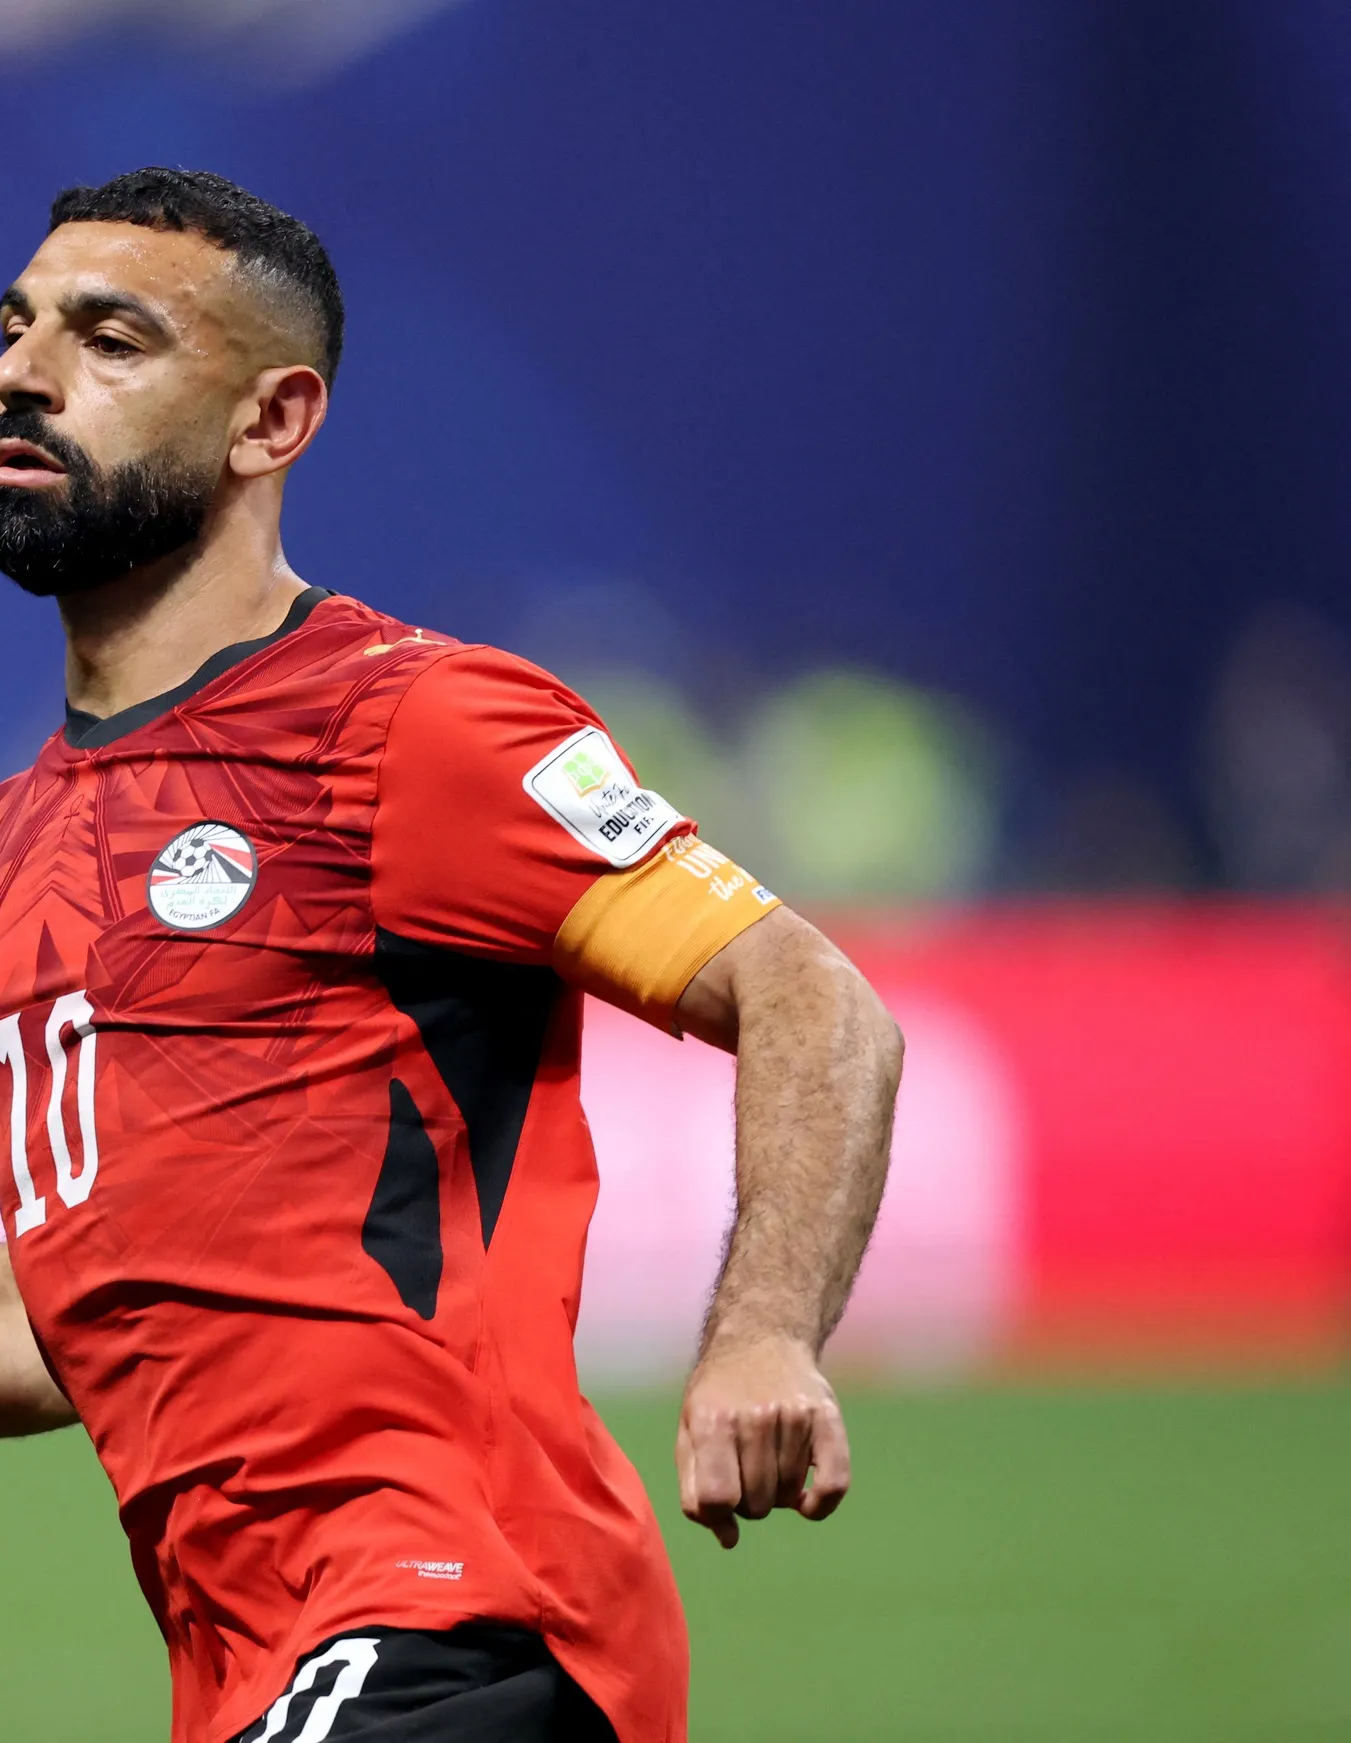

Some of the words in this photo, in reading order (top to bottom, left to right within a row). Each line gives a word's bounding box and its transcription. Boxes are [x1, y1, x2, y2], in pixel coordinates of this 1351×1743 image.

[598, 792, 657, 843] EDUCTION
[633, 815, 655, 835] FIF
[168, 909, 208, 920] EGYPTIAN
[209, 907, 220, 917] FA
[395, 1559, 465, 1574] ULTRAWEAVE
